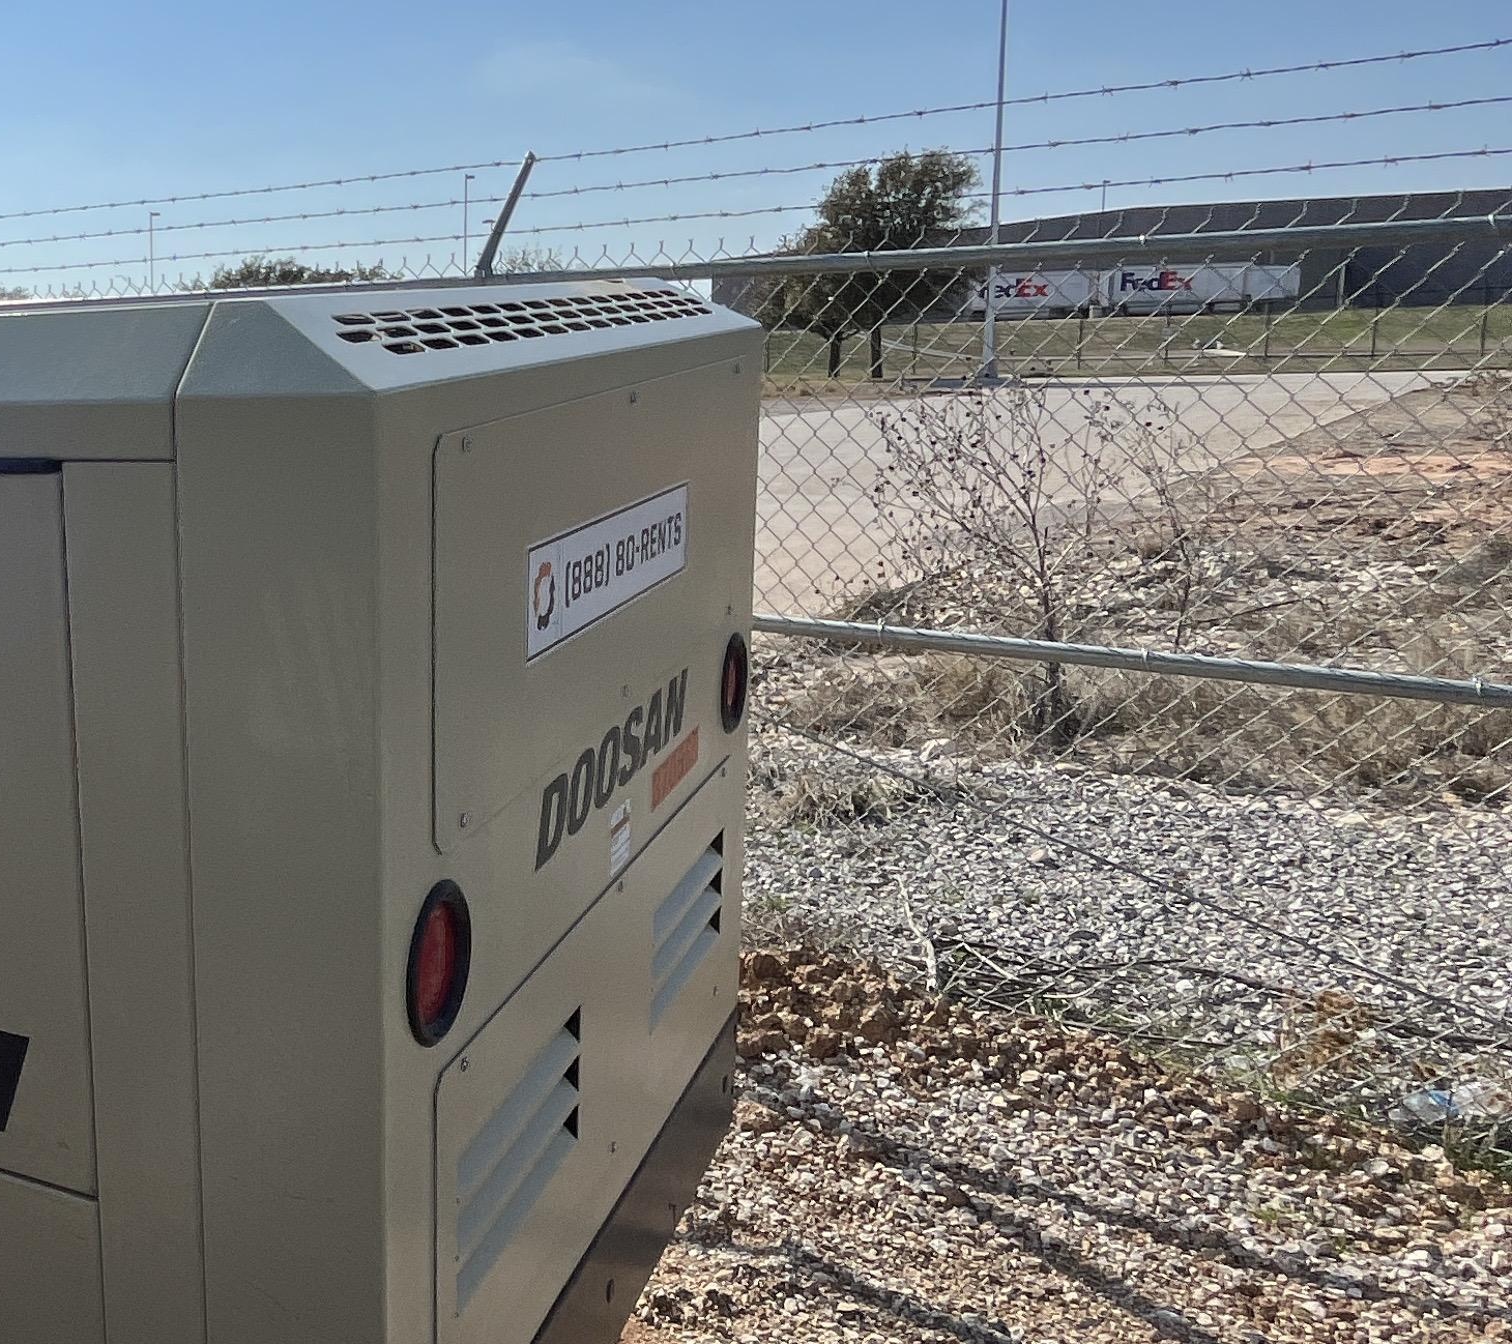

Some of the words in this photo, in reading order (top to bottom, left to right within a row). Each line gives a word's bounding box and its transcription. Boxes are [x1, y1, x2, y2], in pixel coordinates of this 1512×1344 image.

[1120, 271, 1193, 292] FedEx
[564, 542, 611, 608] (888)
[615, 512, 683, 578] 80-RENTS
[535, 668, 689, 873] DOOSAN
